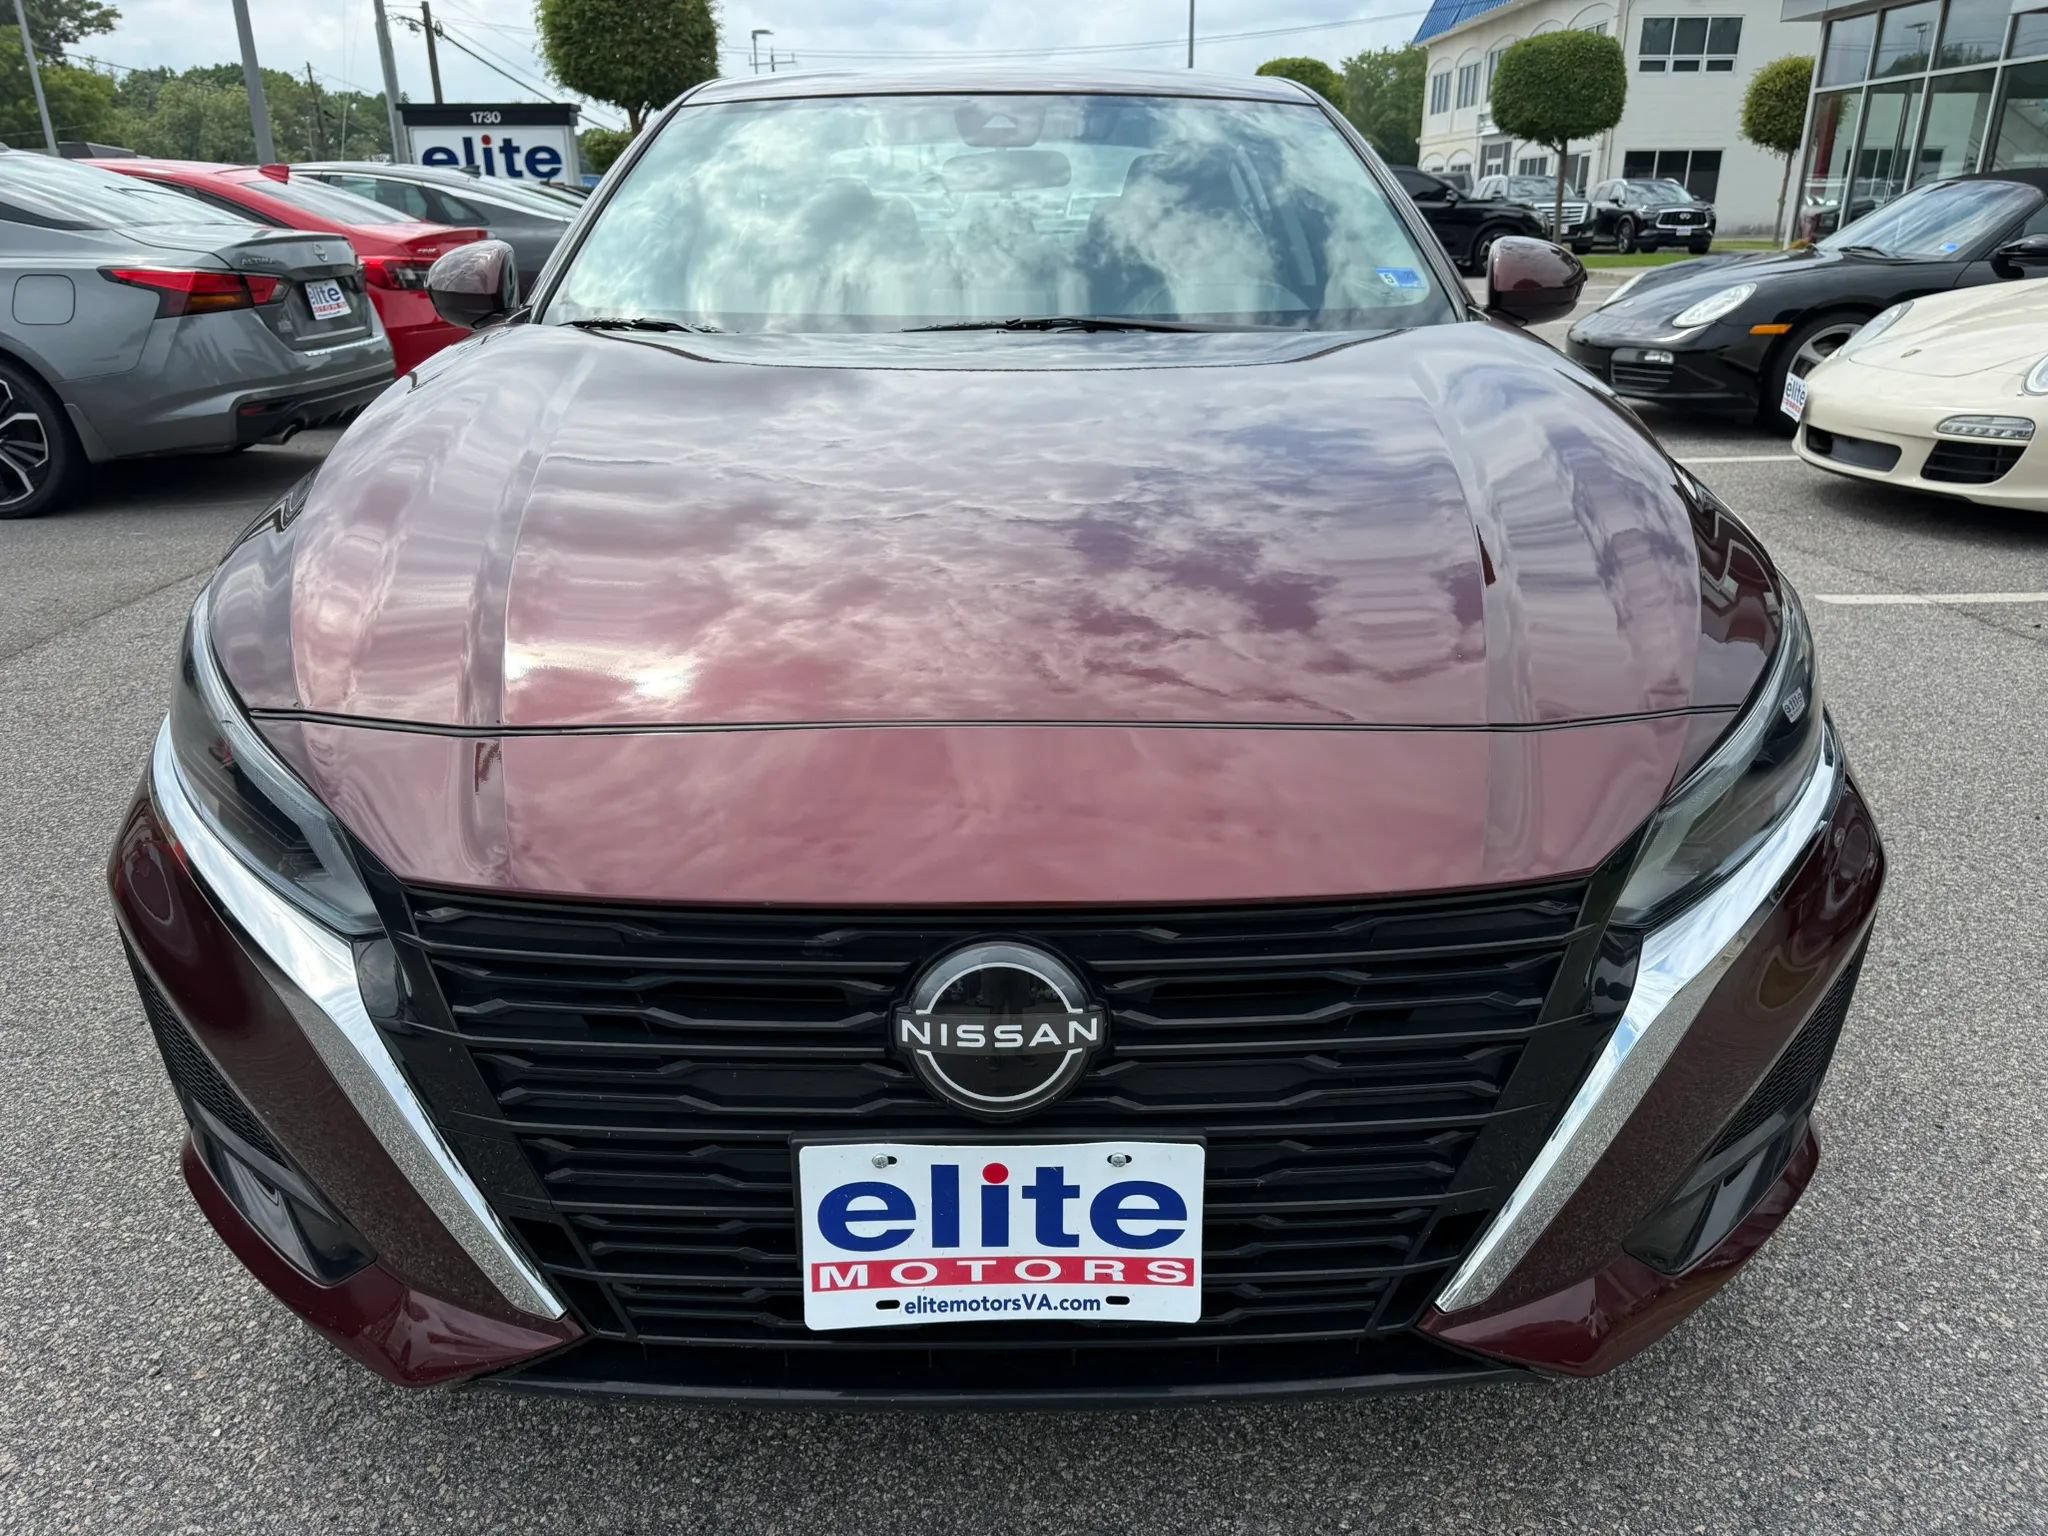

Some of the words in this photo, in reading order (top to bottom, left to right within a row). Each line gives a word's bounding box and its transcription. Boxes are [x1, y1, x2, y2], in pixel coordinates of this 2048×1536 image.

[470, 111, 501, 124] 1730
[422, 134, 563, 179] elite
[901, 1018, 1098, 1048] NISSAN
[817, 1162, 1188, 1252] elite
[818, 1258, 1188, 1289] MOTORS
[904, 1293, 1101, 1314] elitemotorsVA.com
